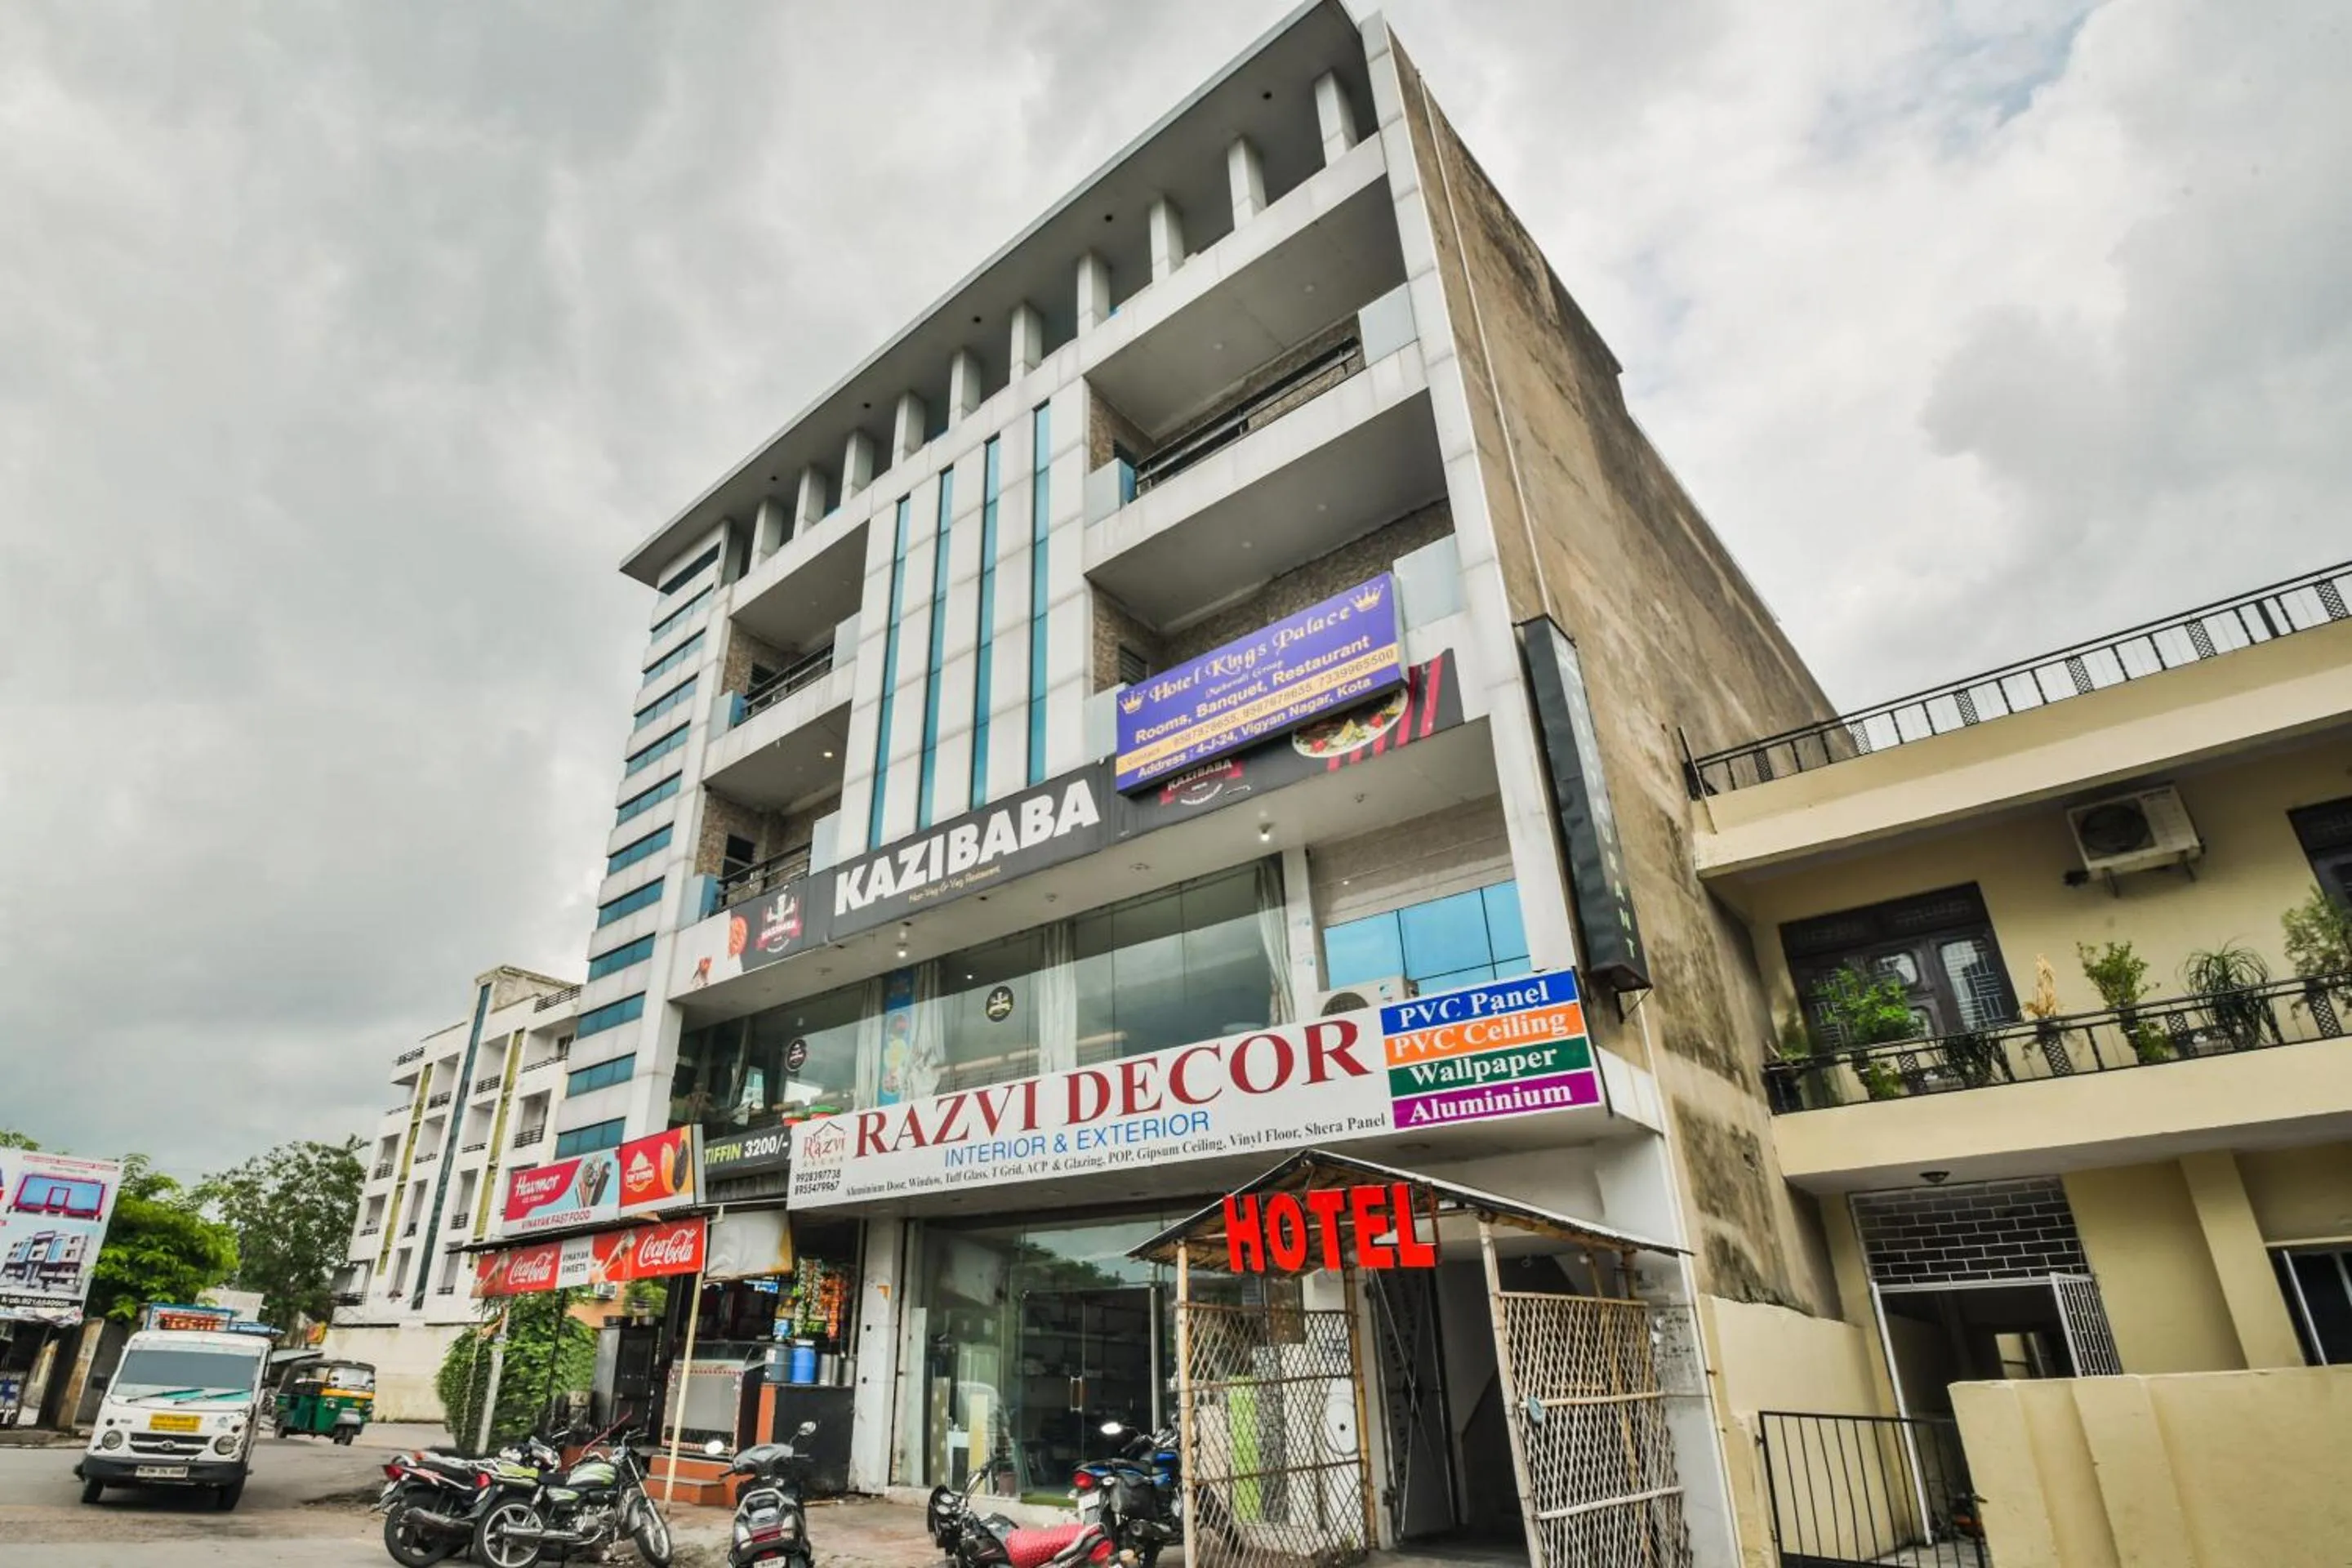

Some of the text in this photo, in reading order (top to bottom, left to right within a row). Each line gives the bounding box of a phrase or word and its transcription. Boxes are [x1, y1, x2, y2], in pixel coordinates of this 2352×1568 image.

[1149, 666, 1201, 703] Hotel
[1205, 643, 1267, 676] Kings
[1272, 607, 1352, 656] Palace
[1135, 714, 1192, 744] Rooms,
[1196, 679, 1268, 718] Banquet,
[1272, 634, 1370, 686] Restaurant
[1138, 751, 1186, 778] Address
[1241, 710, 1285, 736] Vigyan
[1290, 693, 1334, 717] Nagar,
[1337, 677, 1372, 698] Kota
[835, 778, 1101, 916] KAZIBABA
[1399, 980, 1549, 1028] PVC Panel
[1393, 1013, 1569, 1058] PVC Ceiling
[853, 1019, 1374, 1158] RAZVI DECOR
[1409, 1047, 1557, 1086] Wallpaper
[1409, 1085, 1572, 1124] Aluminium
[705, 1134, 788, 1164] TIFFIN 3200/-
[945, 1111, 1209, 1167] INTERIOR & EXTERIOR
[1052, 1160, 1062, 1171] &
[1064, 1155, 1106, 1170] Glazing,
[1108, 1151, 1134, 1164] POP,
[1137, 1144, 1179, 1160] Gipsum
[1183, 1138, 1226, 1154] Ceiling,
[1230, 1130, 1262, 1147] Vinyl
[1265, 1128, 1302, 1143] Floor,
[1305, 1120, 1343, 1137] Shera
[1348, 1111, 1386, 1130] Panel
[1223, 1181, 1438, 1273] HOTEL
